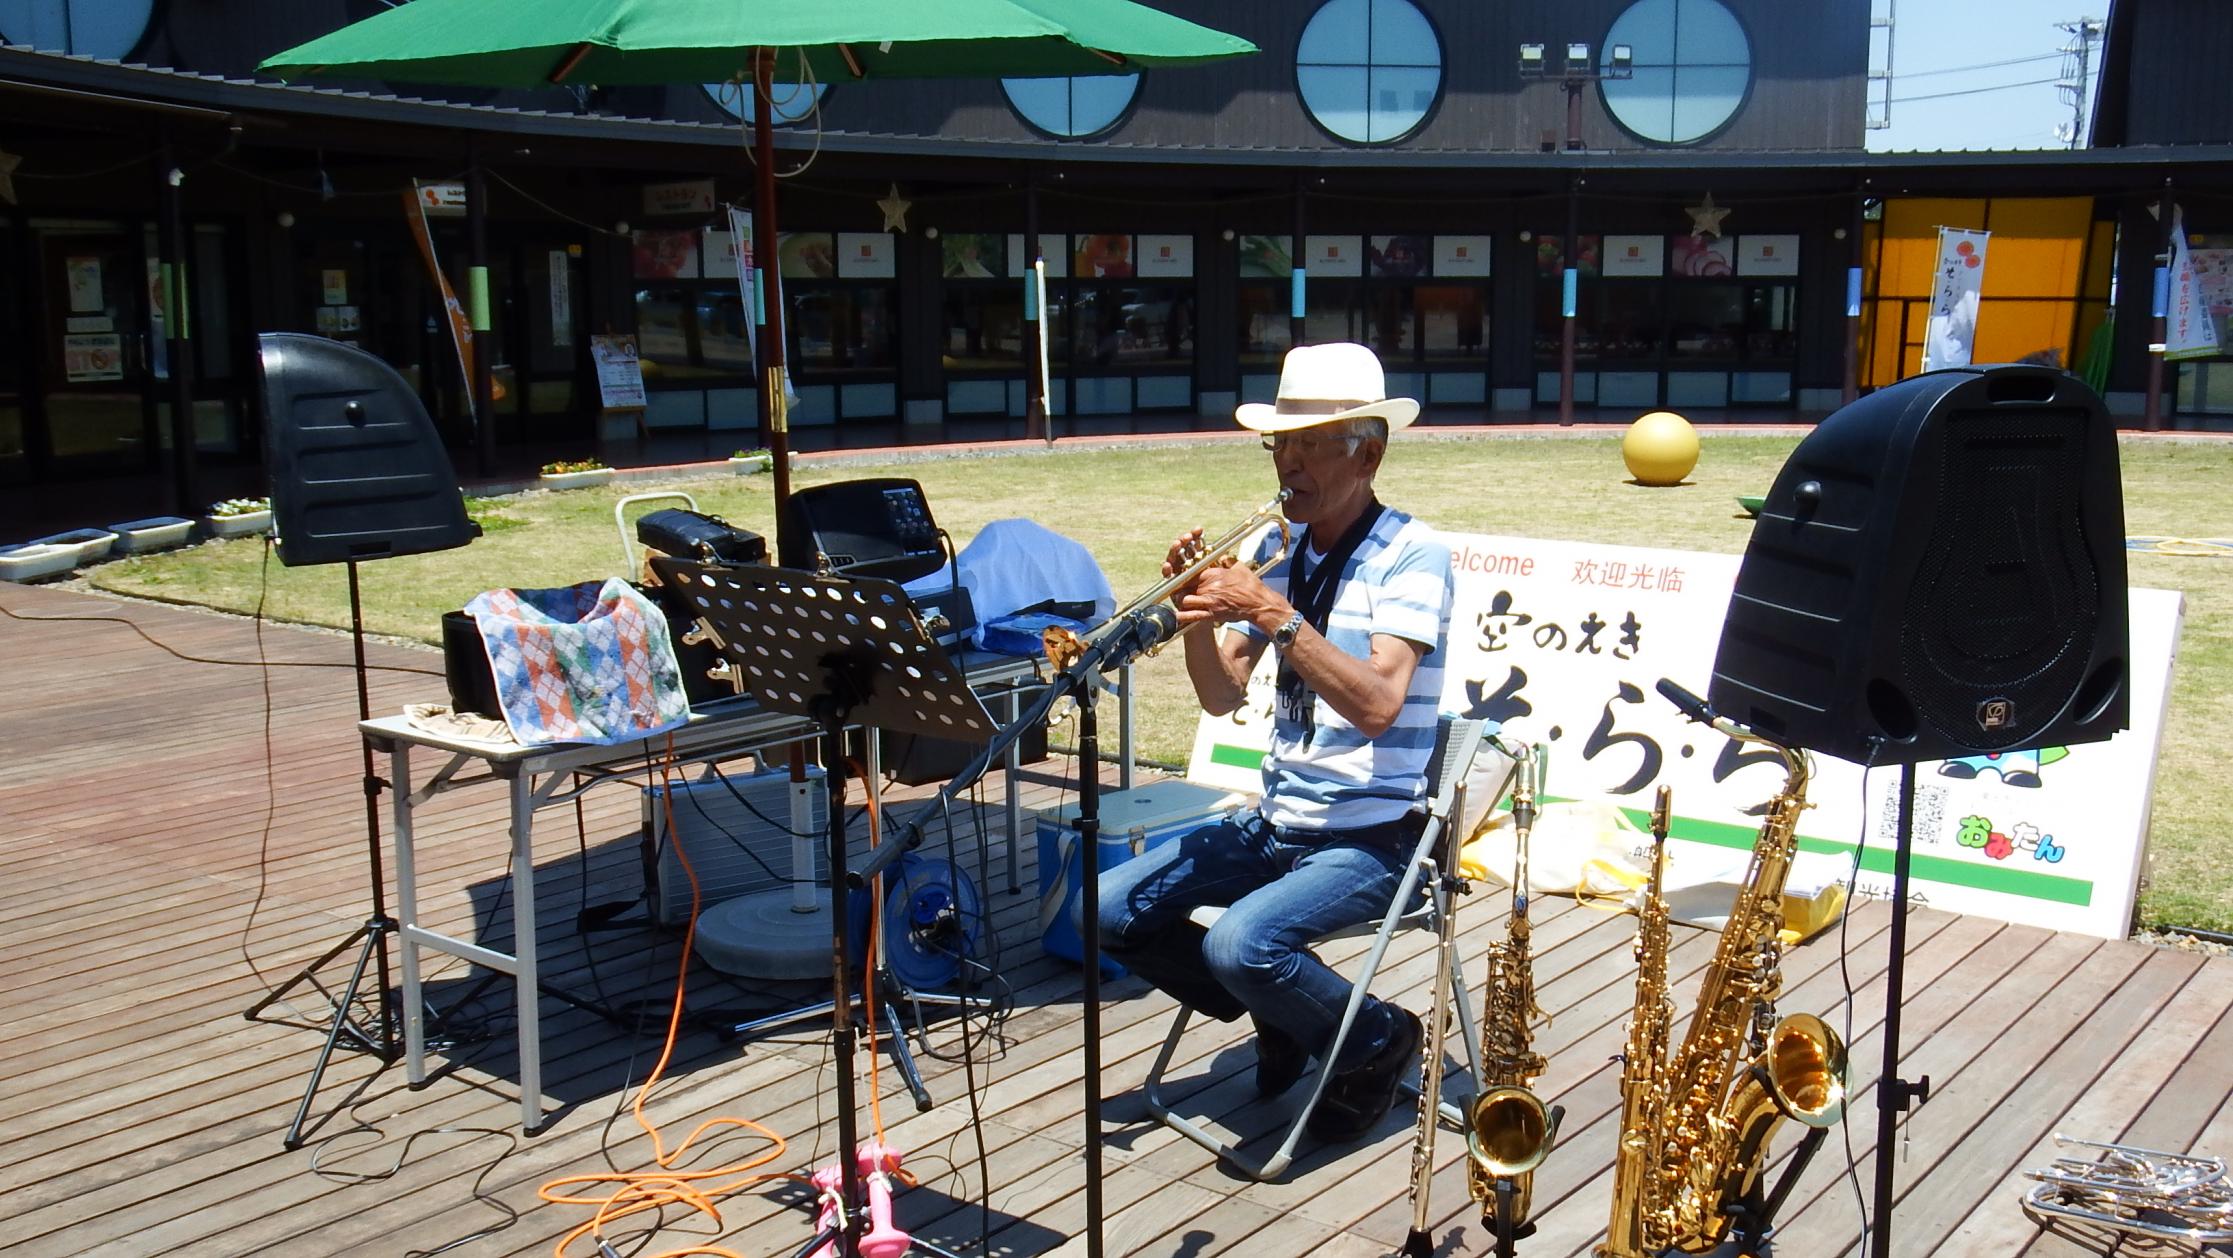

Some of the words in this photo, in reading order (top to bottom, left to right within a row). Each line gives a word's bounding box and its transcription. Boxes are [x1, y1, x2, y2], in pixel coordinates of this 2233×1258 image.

[1450, 546, 1534, 576] elcome
[1571, 558, 1685, 593] 欢迎光临
[1477, 590, 1642, 660] 空のえき
[1957, 815, 2065, 863] おみたん
